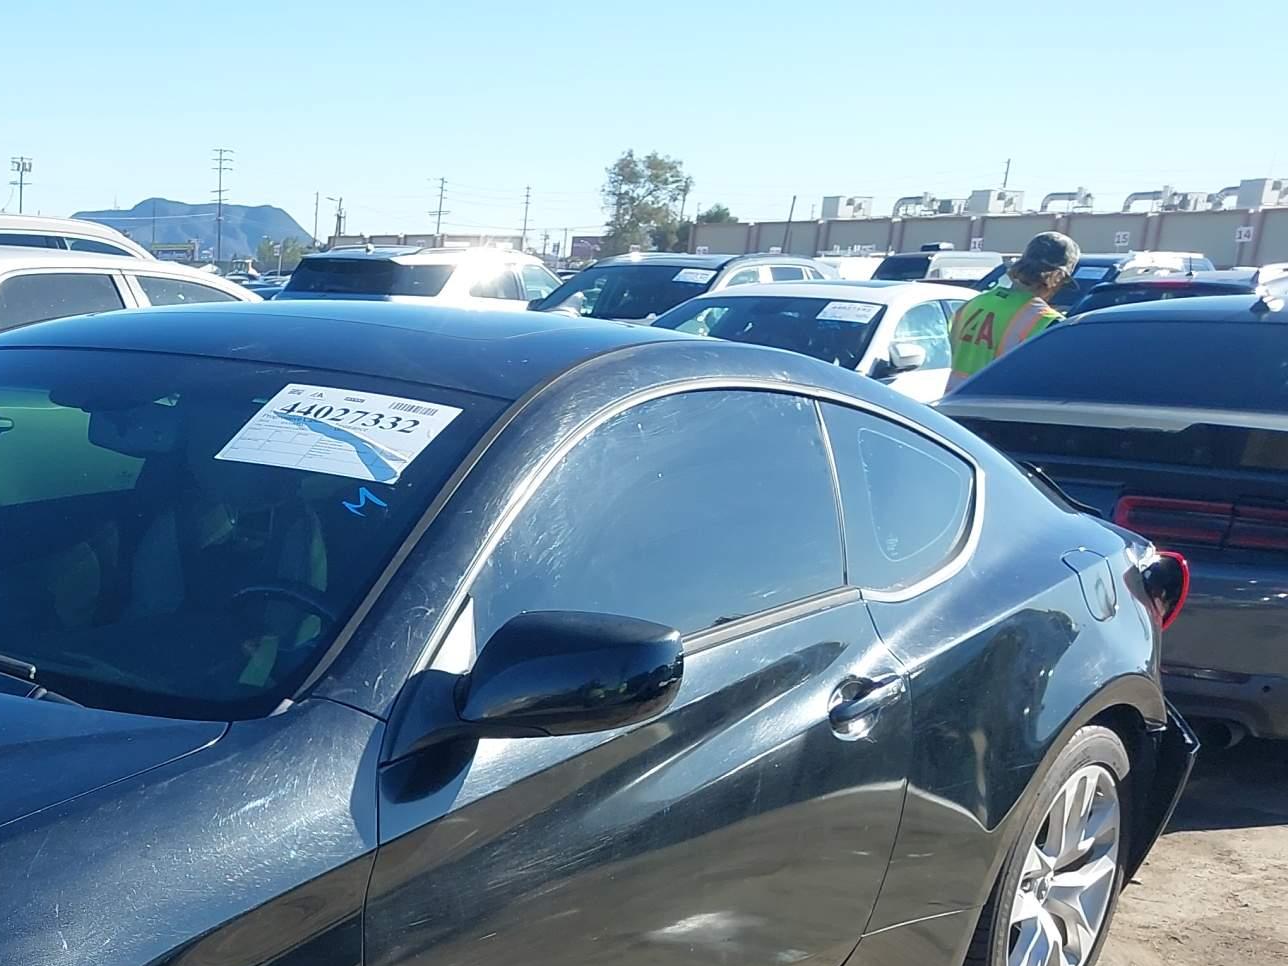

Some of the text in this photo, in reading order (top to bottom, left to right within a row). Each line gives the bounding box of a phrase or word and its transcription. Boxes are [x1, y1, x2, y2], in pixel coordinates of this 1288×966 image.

[1116, 233, 1129, 243] 15
[1237, 229, 1252, 240] 14
[280, 401, 420, 433] 44027332
